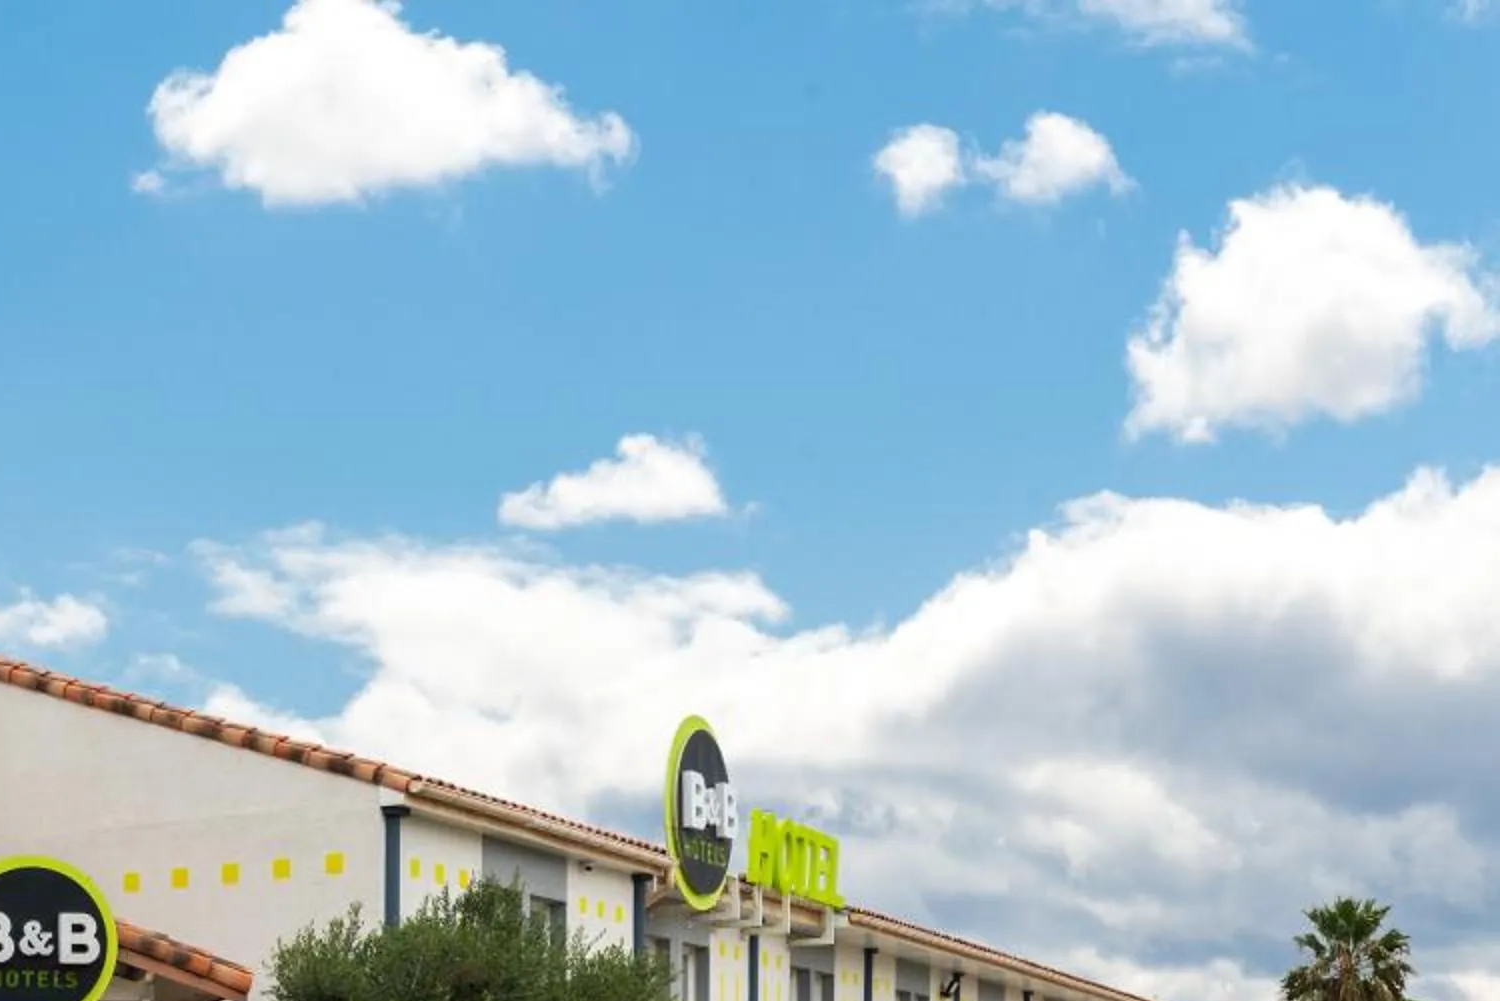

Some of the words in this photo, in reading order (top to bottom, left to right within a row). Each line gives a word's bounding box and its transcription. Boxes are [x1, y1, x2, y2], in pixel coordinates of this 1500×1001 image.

[682, 769, 739, 840] B&B
[683, 836, 727, 868] HOTELS
[747, 807, 846, 909] HOTEL
